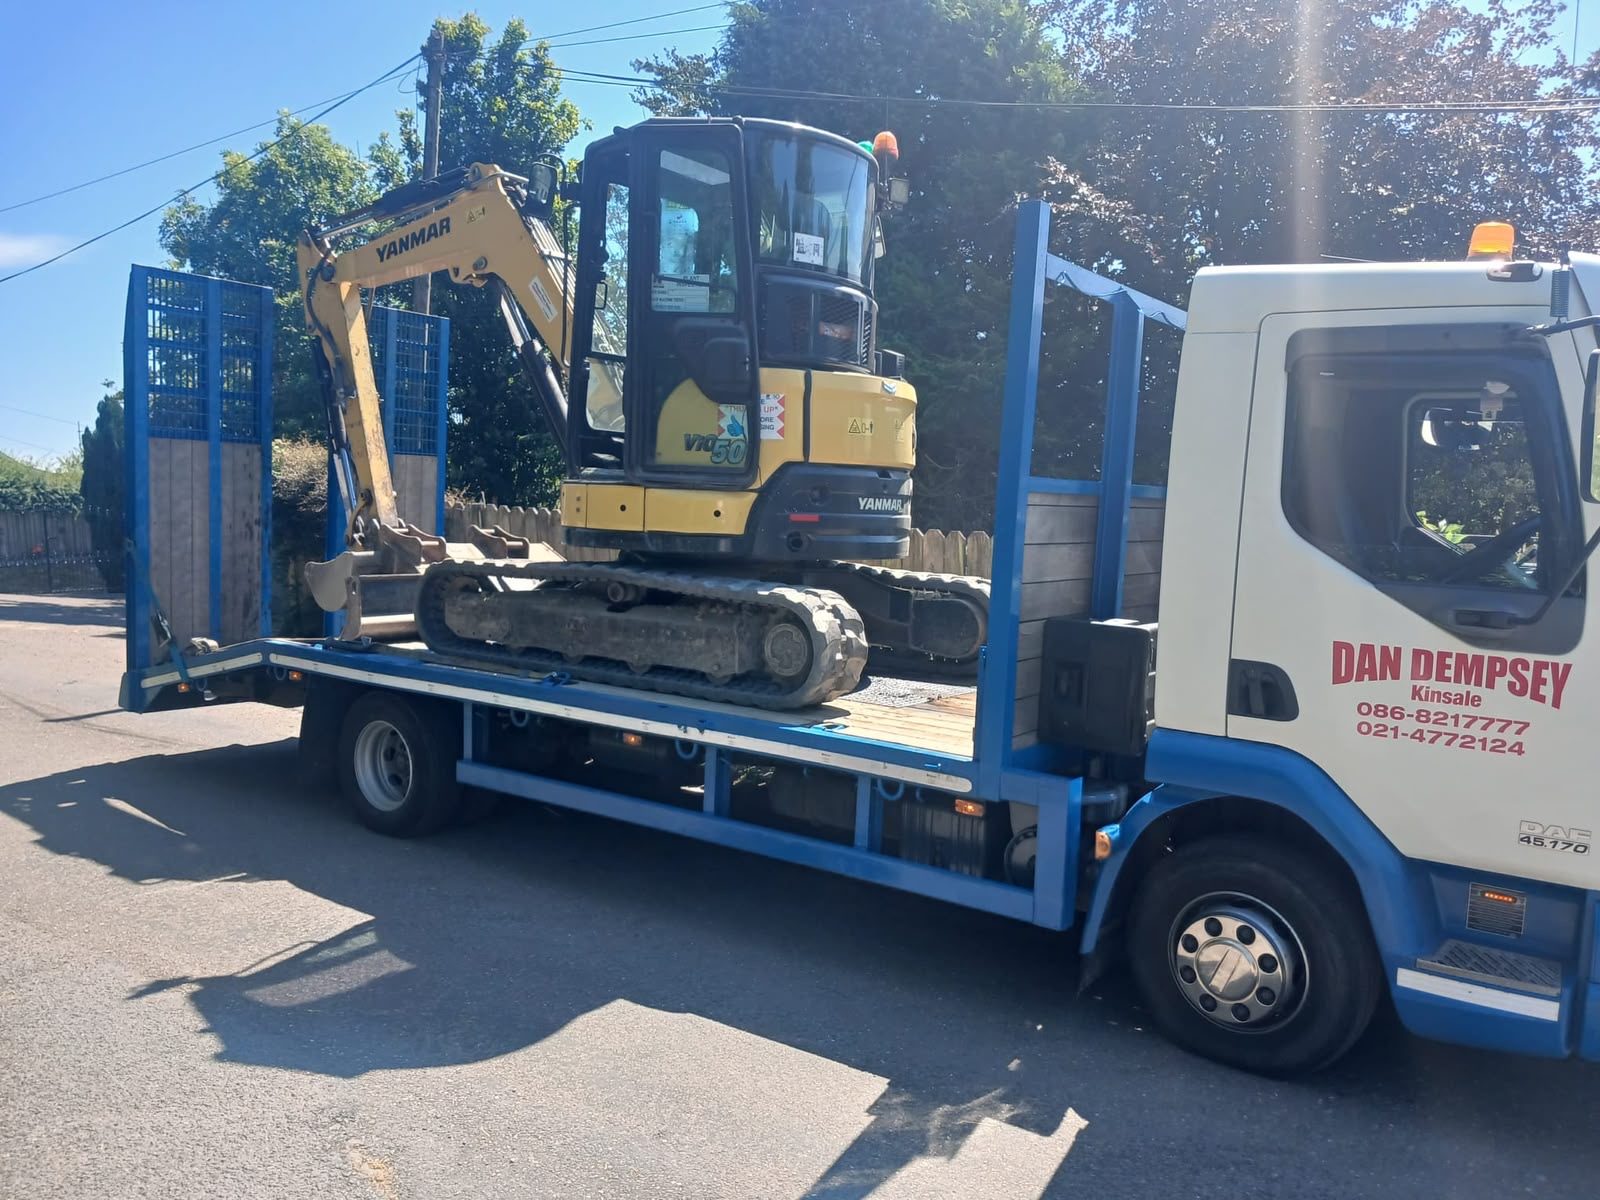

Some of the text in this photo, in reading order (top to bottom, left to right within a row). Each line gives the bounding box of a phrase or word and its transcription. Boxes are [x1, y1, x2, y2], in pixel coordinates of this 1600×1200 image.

[376, 217, 451, 263] YANMAR
[858, 497, 902, 511] YANMAR
[1332, 640, 1573, 709] DAN DEMPSEY
[1411, 685, 1482, 708] Kinsale
[1356, 702, 1530, 735] 086-8217777
[1356, 721, 1525, 756] 021-4772124
[1519, 820, 1592, 844] DAF
[1520, 835, 1588, 853] 45.170
